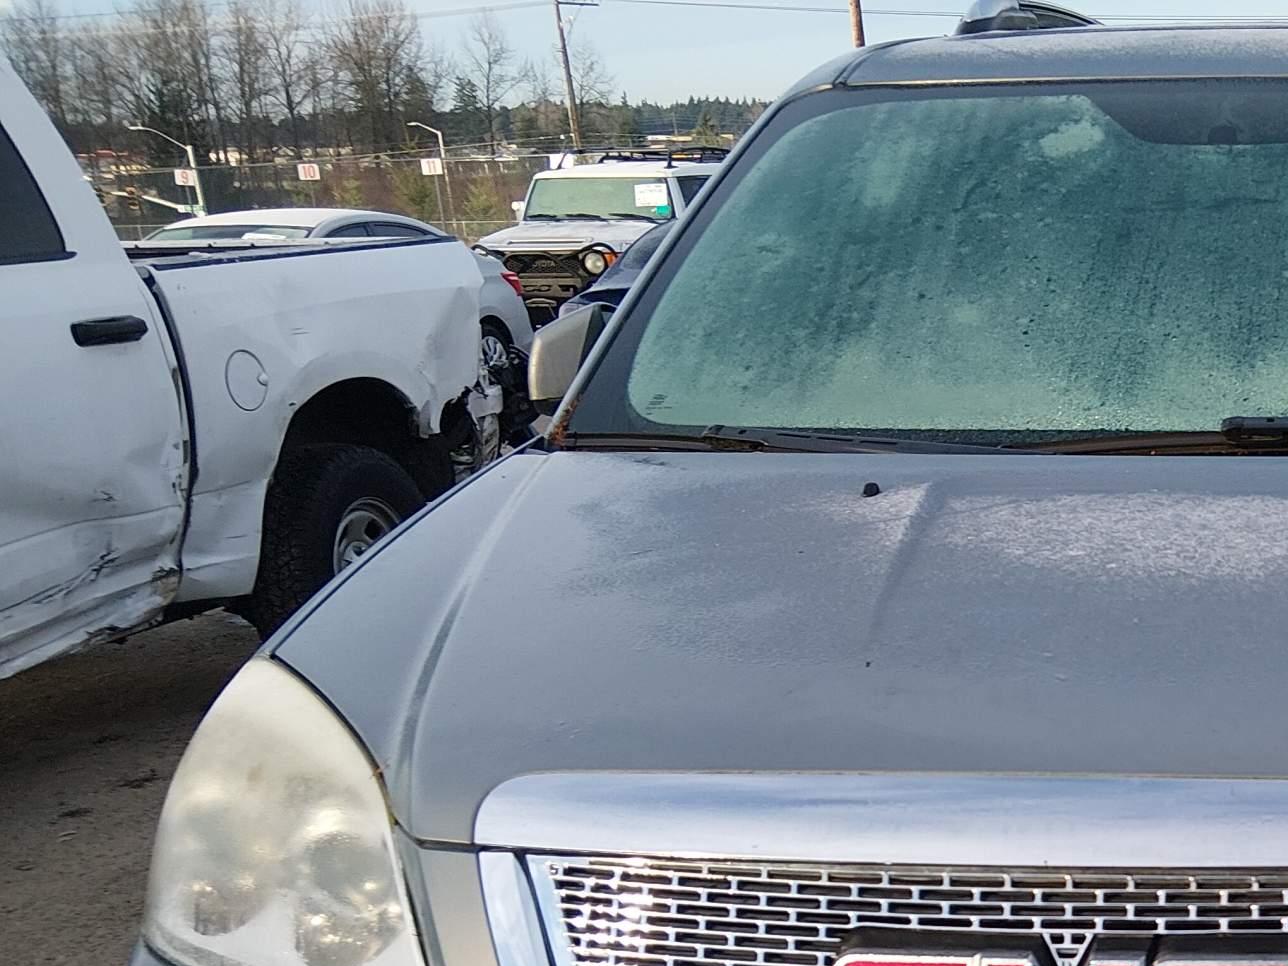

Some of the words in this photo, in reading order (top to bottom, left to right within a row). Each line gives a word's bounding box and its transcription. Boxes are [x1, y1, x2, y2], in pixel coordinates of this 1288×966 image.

[302, 165, 315, 178] 10
[426, 160, 438, 173] 11
[180, 171, 190, 184] 9
